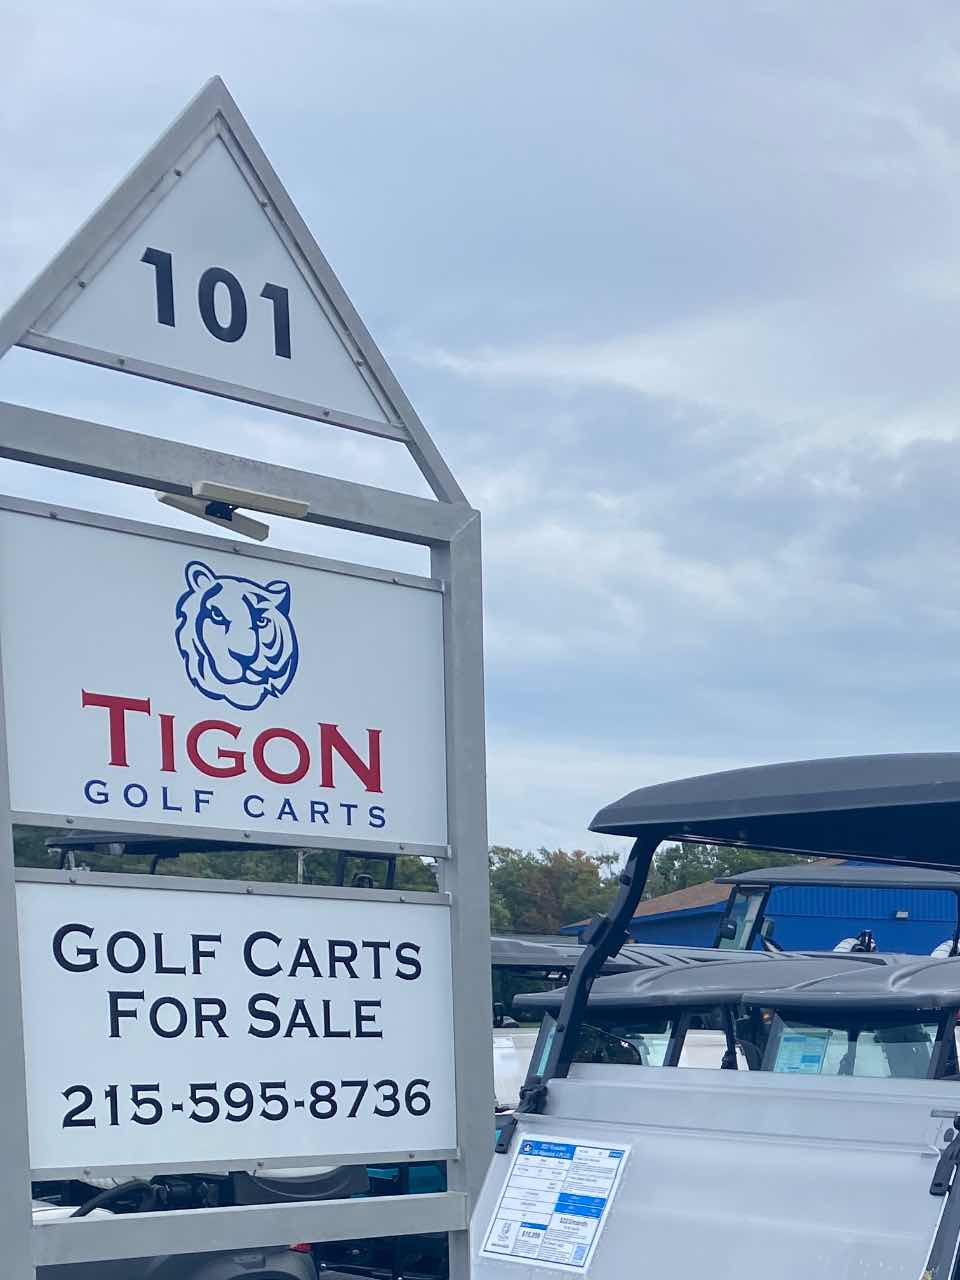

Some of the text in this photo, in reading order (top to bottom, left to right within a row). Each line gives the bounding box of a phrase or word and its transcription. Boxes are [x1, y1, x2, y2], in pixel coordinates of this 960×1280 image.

[139, 247, 292, 360] 101
[81, 688, 384, 794] TIGON
[84, 779, 386, 829] GOLF CARTS
[52, 923, 422, 981] GOLF CARTS
[107, 989, 383, 1039] FOR SALE
[61, 1078, 432, 1129] 215-595-8736
